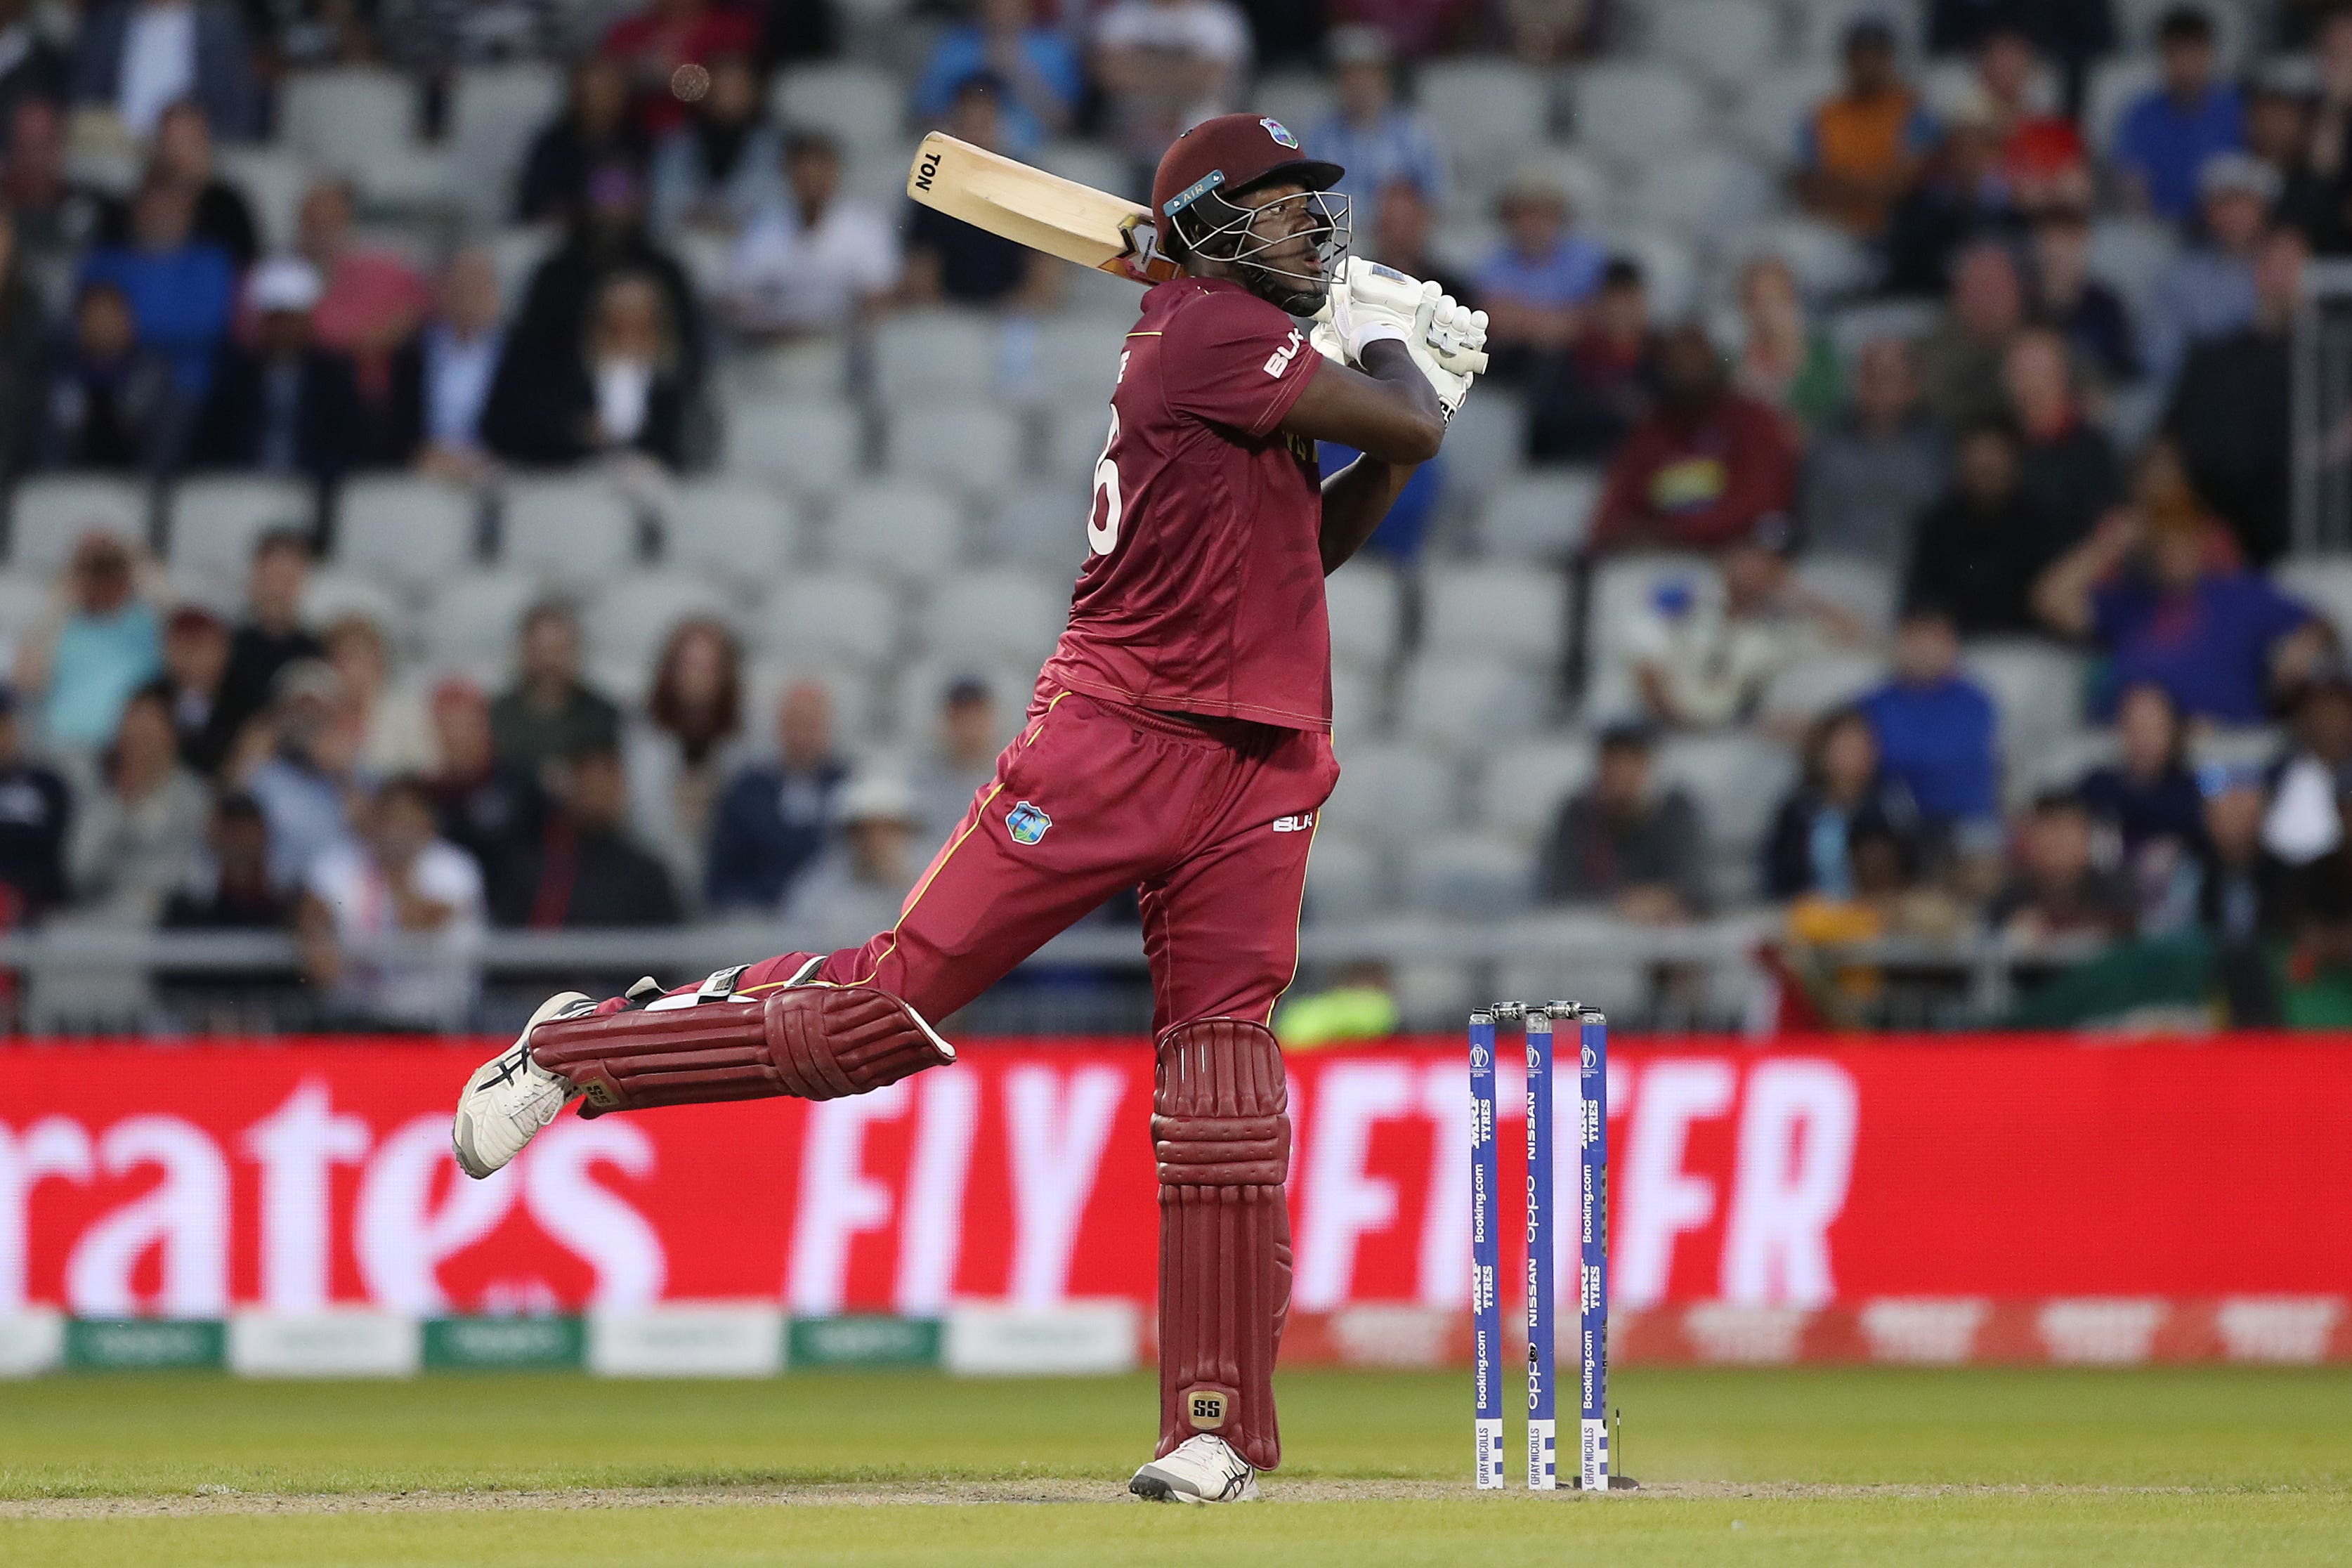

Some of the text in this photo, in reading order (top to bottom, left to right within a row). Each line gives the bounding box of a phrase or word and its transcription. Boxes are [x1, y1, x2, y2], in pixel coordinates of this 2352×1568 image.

[915, 154, 941, 191] TON
[1183, 184, 1203, 203] AIR
[1263, 328, 1304, 379] BLK
[1273, 812, 1312, 832] BLK
[1482, 1099, 1491, 1142] TYRES
[1527, 1092, 1536, 1160] NISSAN
[1588, 1099, 1599, 1142] TYRES
[1475, 1164, 1487, 1243] Booking.com
[1582, 1165, 1594, 1243] Booking.com
[1483, 1266, 1493, 1308] TYRES
[1529, 1258, 1538, 1327] NISSAN
[1590, 1266, 1600, 1308] TYRES
[1477, 1331, 1489, 1409] Booking.com
[1583, 1331, 1595, 1409] Booking.com
[1194, 1399, 1220, 1418] SS
